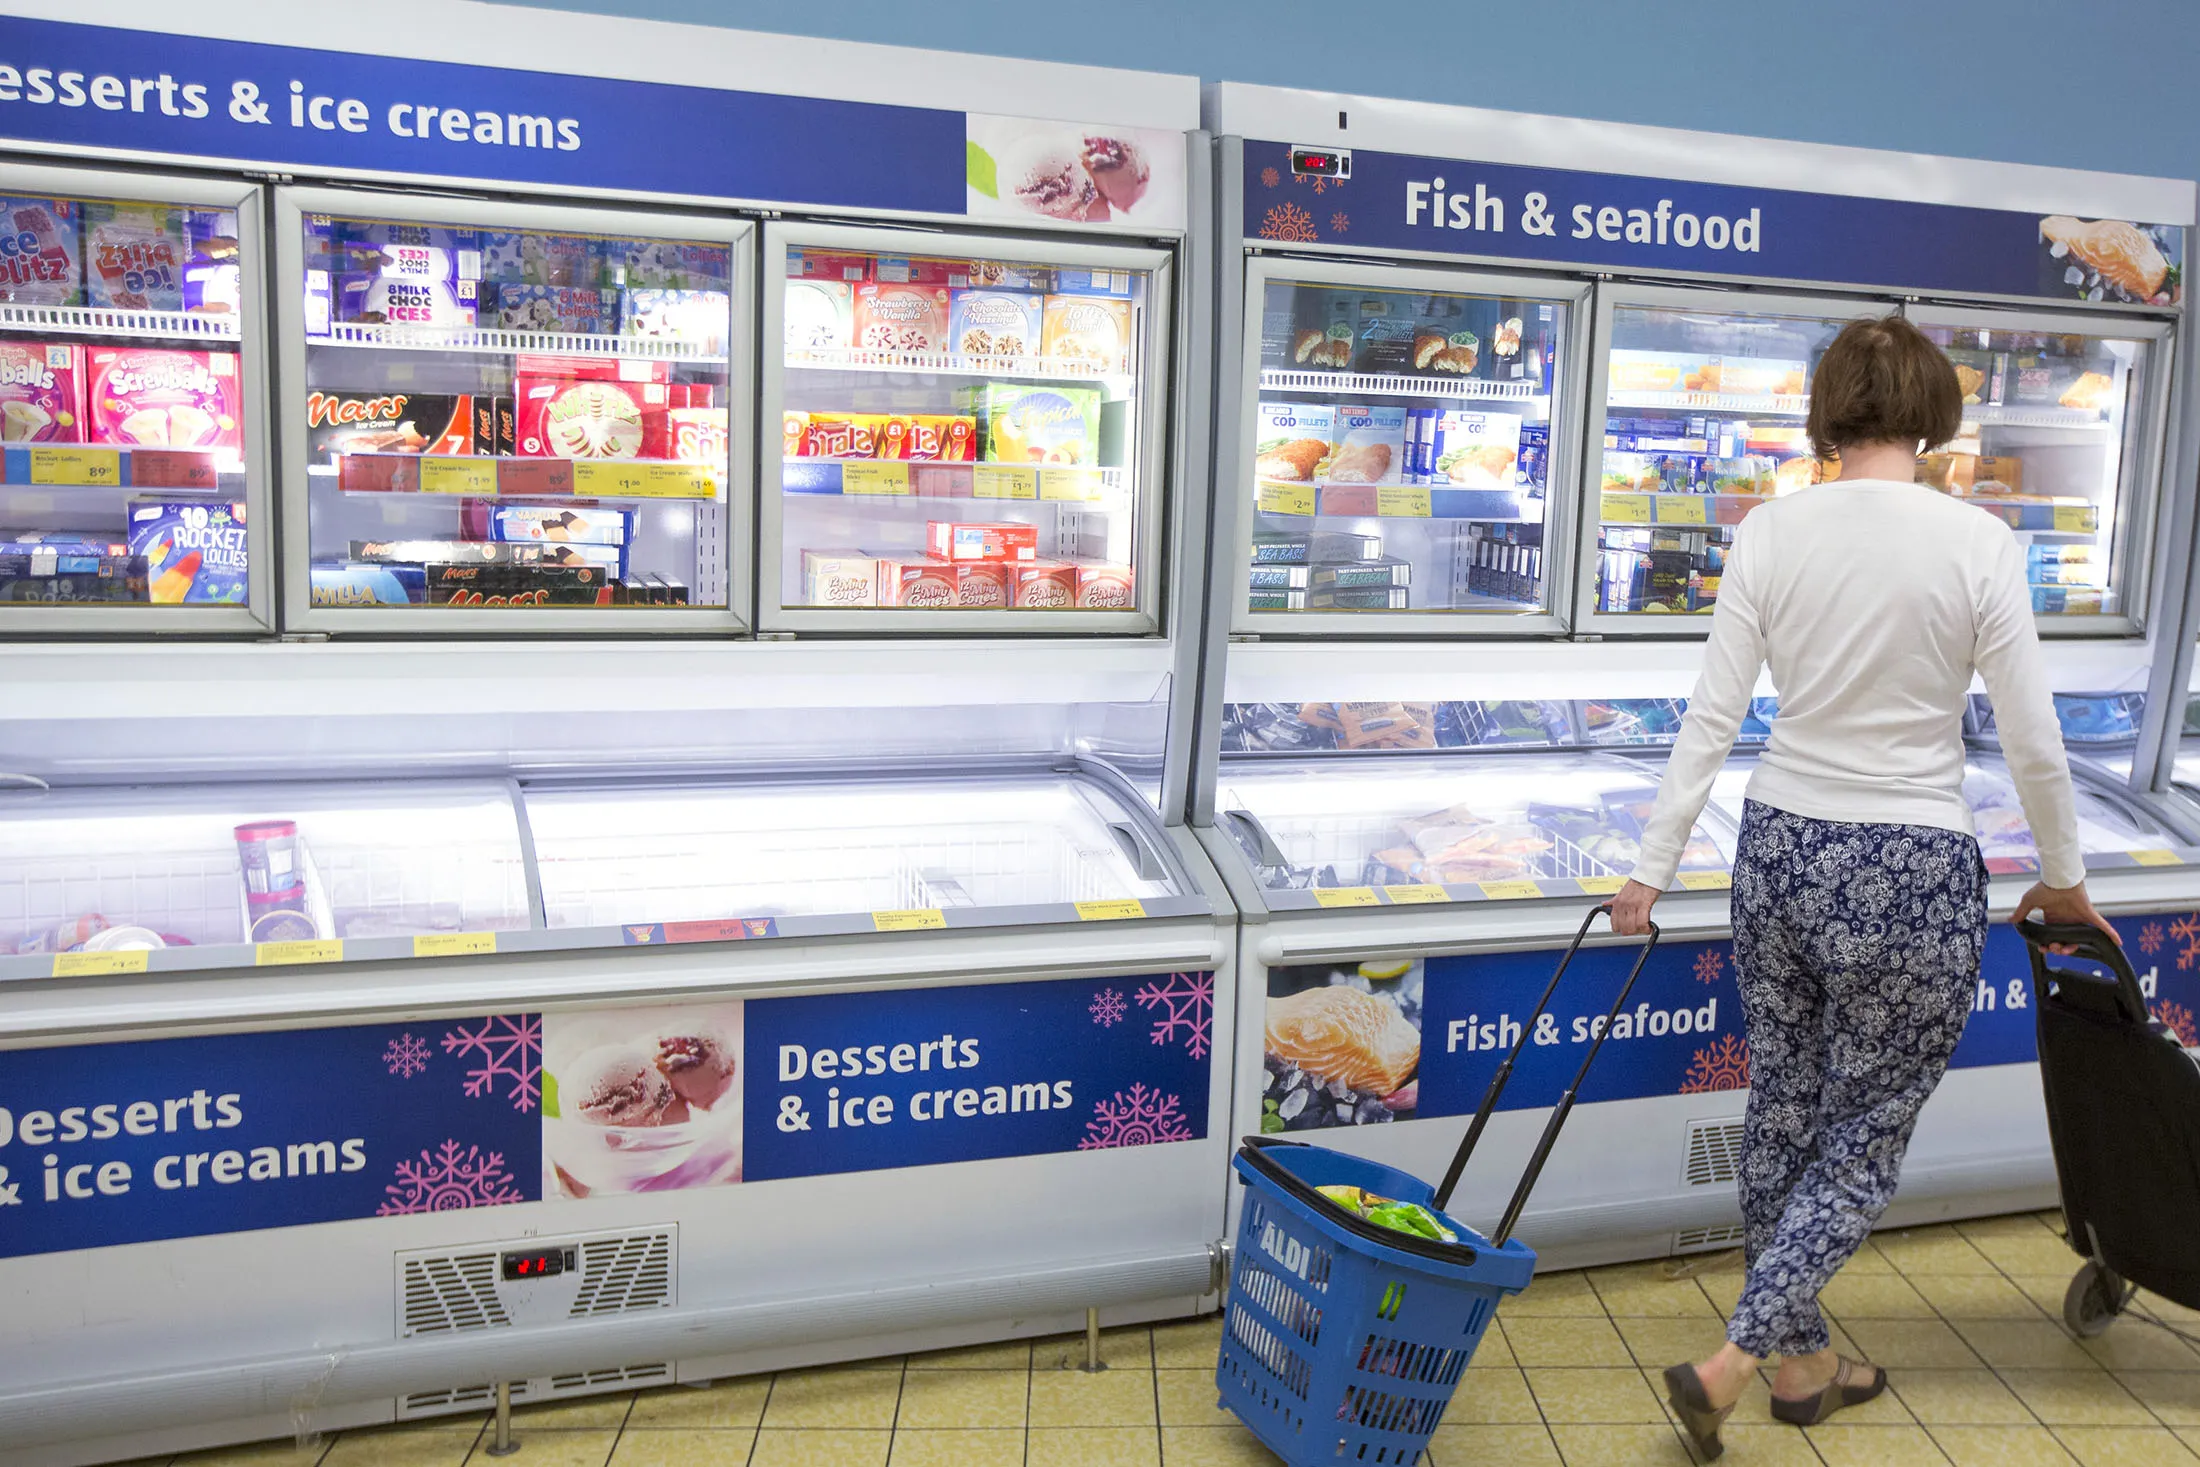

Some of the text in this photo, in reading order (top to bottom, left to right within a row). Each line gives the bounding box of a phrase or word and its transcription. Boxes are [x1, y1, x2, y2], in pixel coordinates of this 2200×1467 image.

[228, 81, 272, 126] &
[288, 80, 370, 133] ice
[387, 101, 582, 151] creams
[1405, 177, 1761, 253] Fish & seafood
[398, 249, 430, 261] ICES
[398, 260, 430, 268] CHOC
[124, 265, 176, 293] ice
[388, 295, 432, 307] CHOC
[559, 289, 599, 305] 8 Milk
[557, 304, 600, 318] Lollies
[866, 296, 931, 313] Strawberry
[967, 300, 1023, 314] Chocolate
[388, 307, 433, 322] ICES
[880, 308, 921, 323] Vanilla
[968, 311, 1018, 325] Hazelnut
[1361, 318, 1380, 341] 2
[50, 352, 68, 366] £1
[108, 365, 218, 395] Screwballs
[307, 392, 408, 428] Mars
[1272, 416, 1329, 427] COD FILLETS
[1349, 416, 1373, 428] COD
[888, 424, 901, 436] £1
[953, 425, 966, 436] £1
[446, 435, 464, 456] 7
[527, 440, 537, 450] 5
[180, 507, 209, 529] 10
[172, 527, 247, 550] ROCKET
[203, 549, 248, 568] LOLLIES
[1259, 548, 1305, 561] SEA BASS
[442, 567, 479, 580] Mars
[1257, 572, 1287, 584] BASS
[829, 576, 839, 587] 12
[959, 582, 970, 593] 12
[825, 587, 868, 601] Cones
[911, 584, 921, 595] 12
[1028, 584, 1038, 595] 12
[1089, 584, 1099, 595] 12
[907, 595, 951, 607] Cones
[958, 591, 998, 605] Cones
[1024, 595, 1065, 608] Cones
[1085, 595, 1126, 608] Cones
[2005, 978, 2027, 1010] &
[1447, 998, 1717, 1053] Fish & seafood
[779, 1034, 980, 1082] Desserts
[776, 1079, 1073, 1133] & ice creams
[43, 1153, 132, 1202] ice
[153, 1137, 367, 1190] creams
[1260, 1220, 1310, 1281] ALDI
